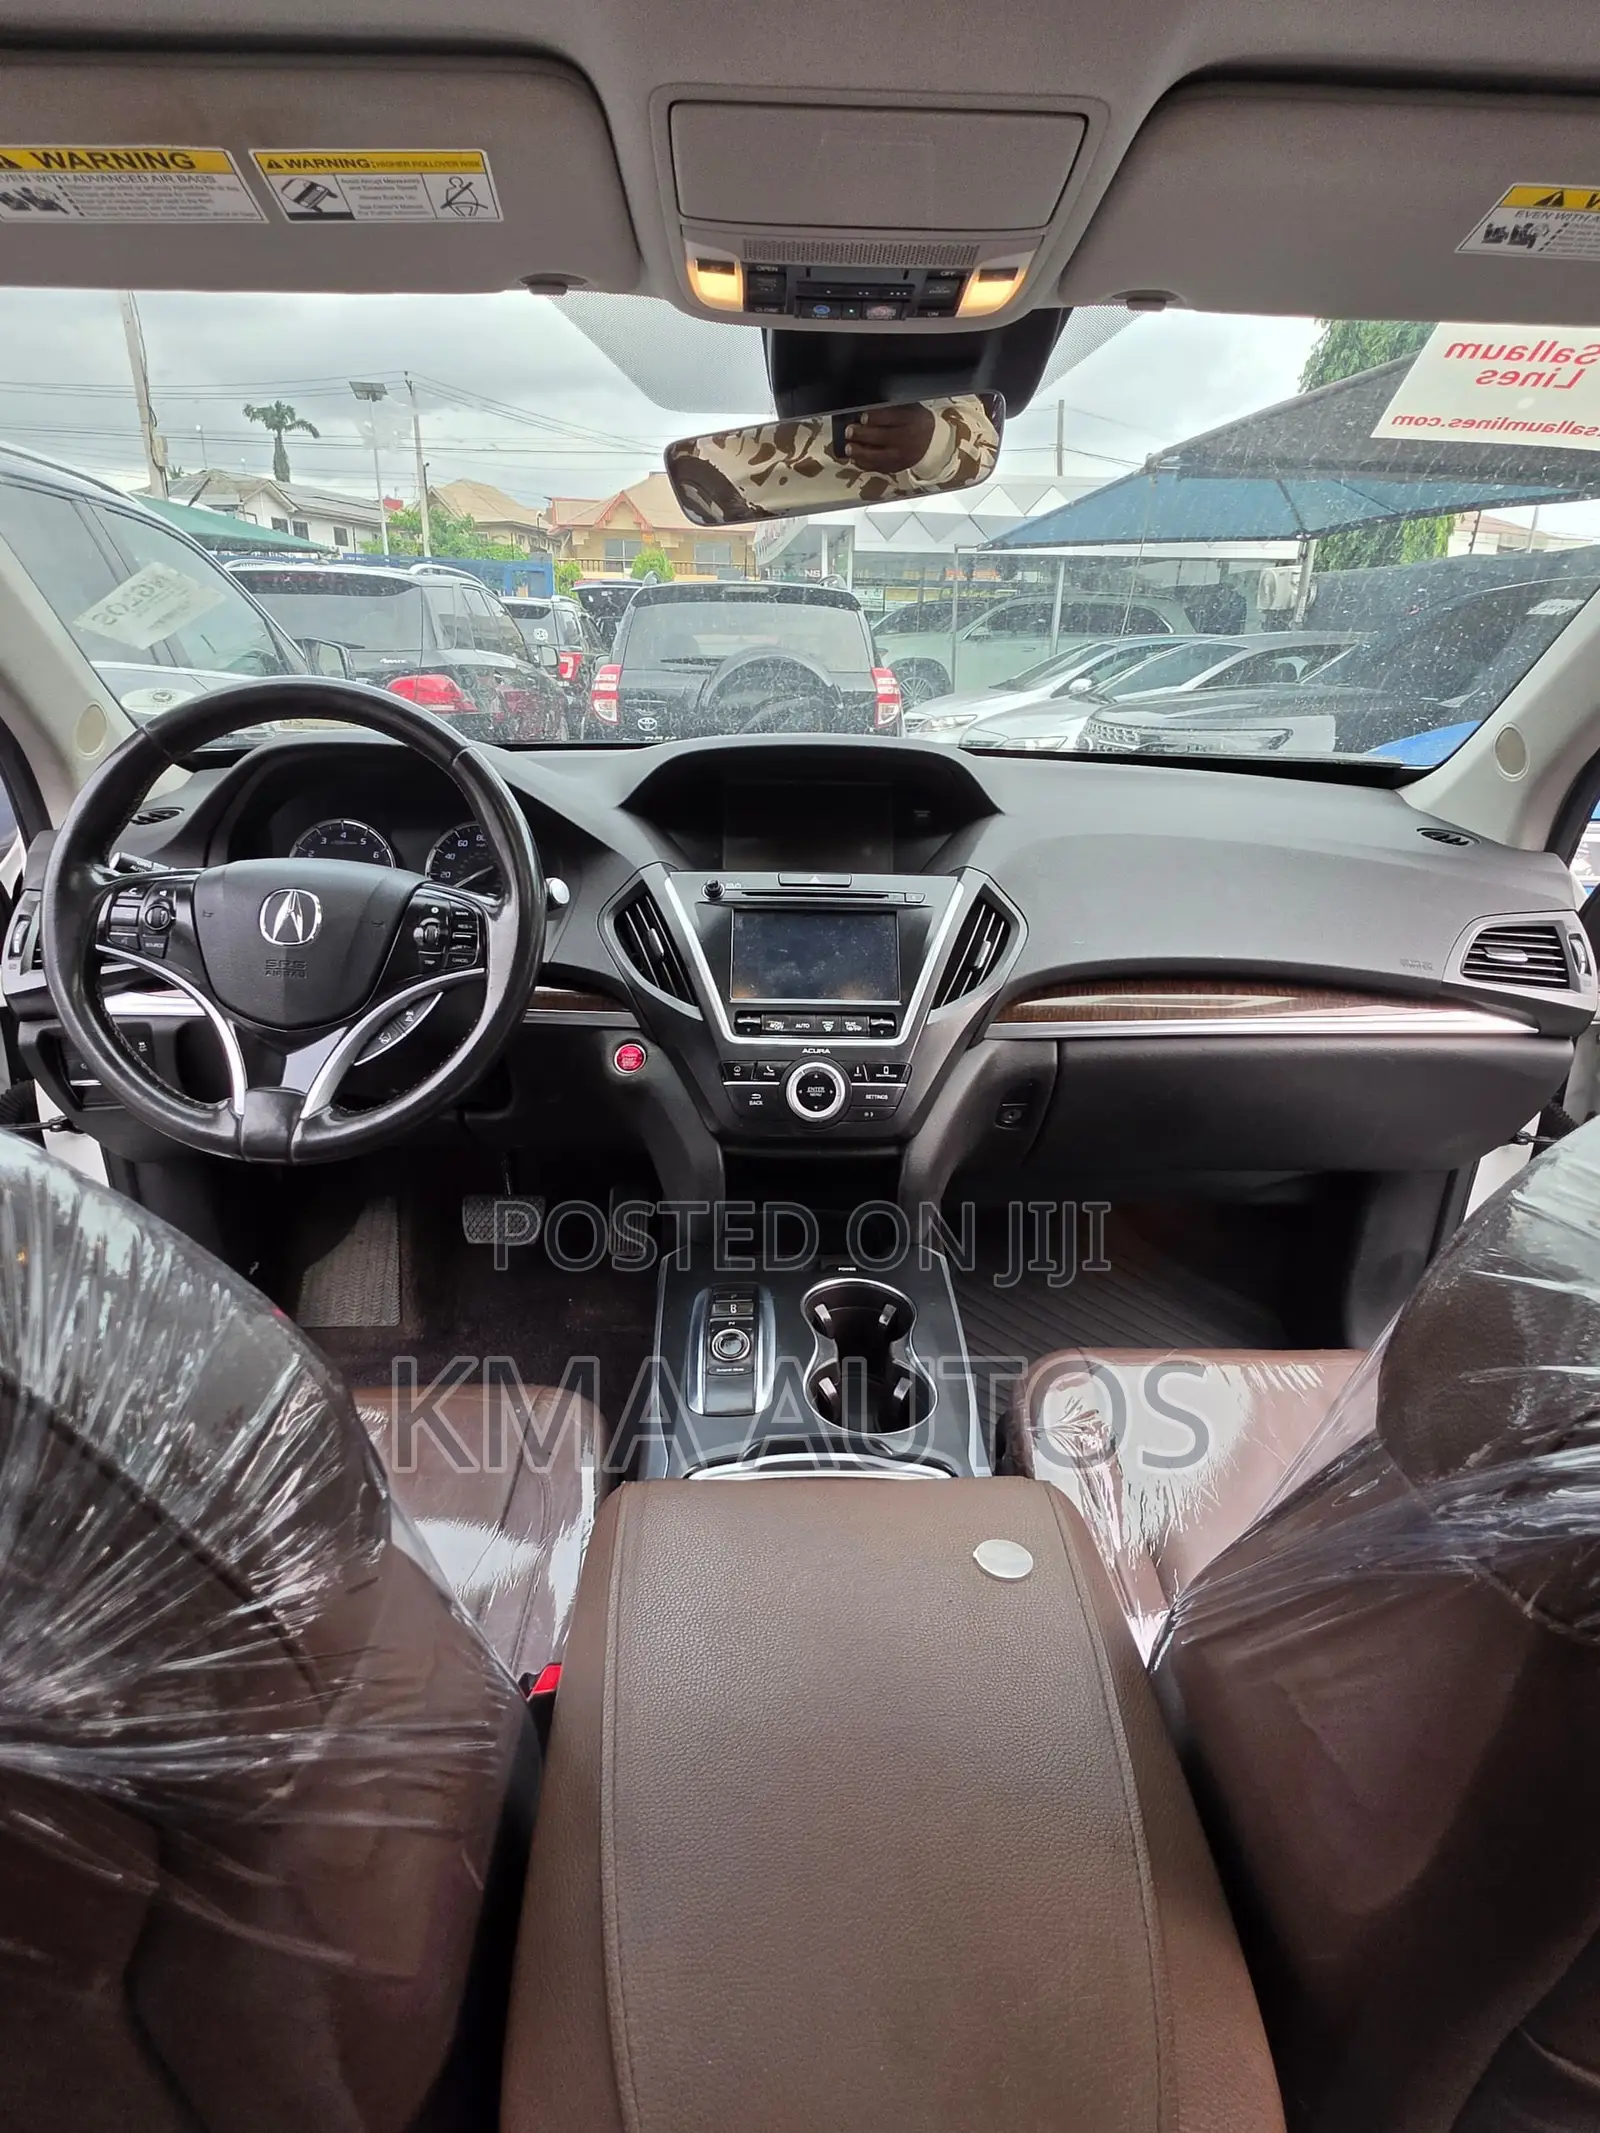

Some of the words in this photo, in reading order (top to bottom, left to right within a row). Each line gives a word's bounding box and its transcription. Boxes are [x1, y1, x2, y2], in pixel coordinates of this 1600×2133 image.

[29, 152, 197, 169] WARNING
[0, 173, 31, 182] VEN
[33, 174, 70, 182] WITH
[73, 174, 148, 183] ADVANCED
[151, 175, 175, 183] AIR
[176, 175, 217, 183] BAGS
[1515, 210, 1551, 219] EVEN
[320, 837, 327, 845] 3
[457, 839, 468, 847] 60
[373, 851, 380, 859] 6
[265, 959, 308, 970] SRS
